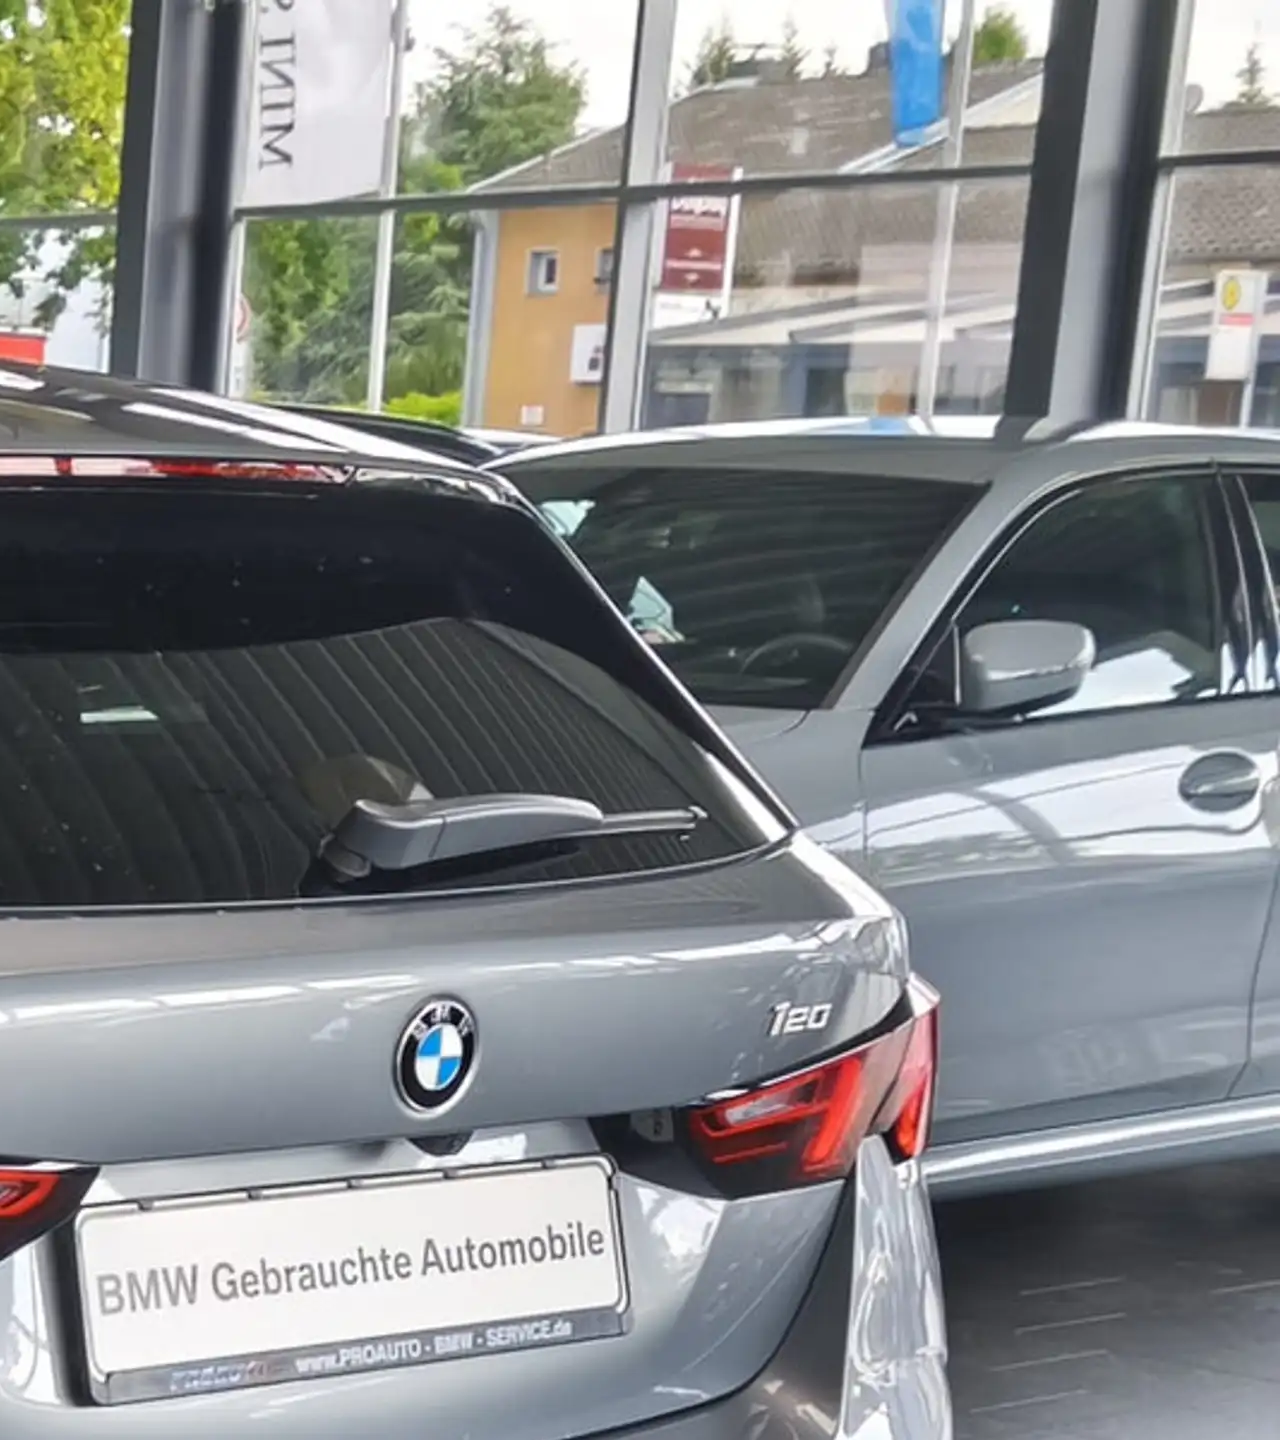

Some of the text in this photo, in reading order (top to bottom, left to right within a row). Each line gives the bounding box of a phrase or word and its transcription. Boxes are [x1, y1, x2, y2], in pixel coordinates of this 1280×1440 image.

[770, 1001, 832, 1037] 120
[96, 1220, 606, 1316] BMW Gebrauchte Automobile
